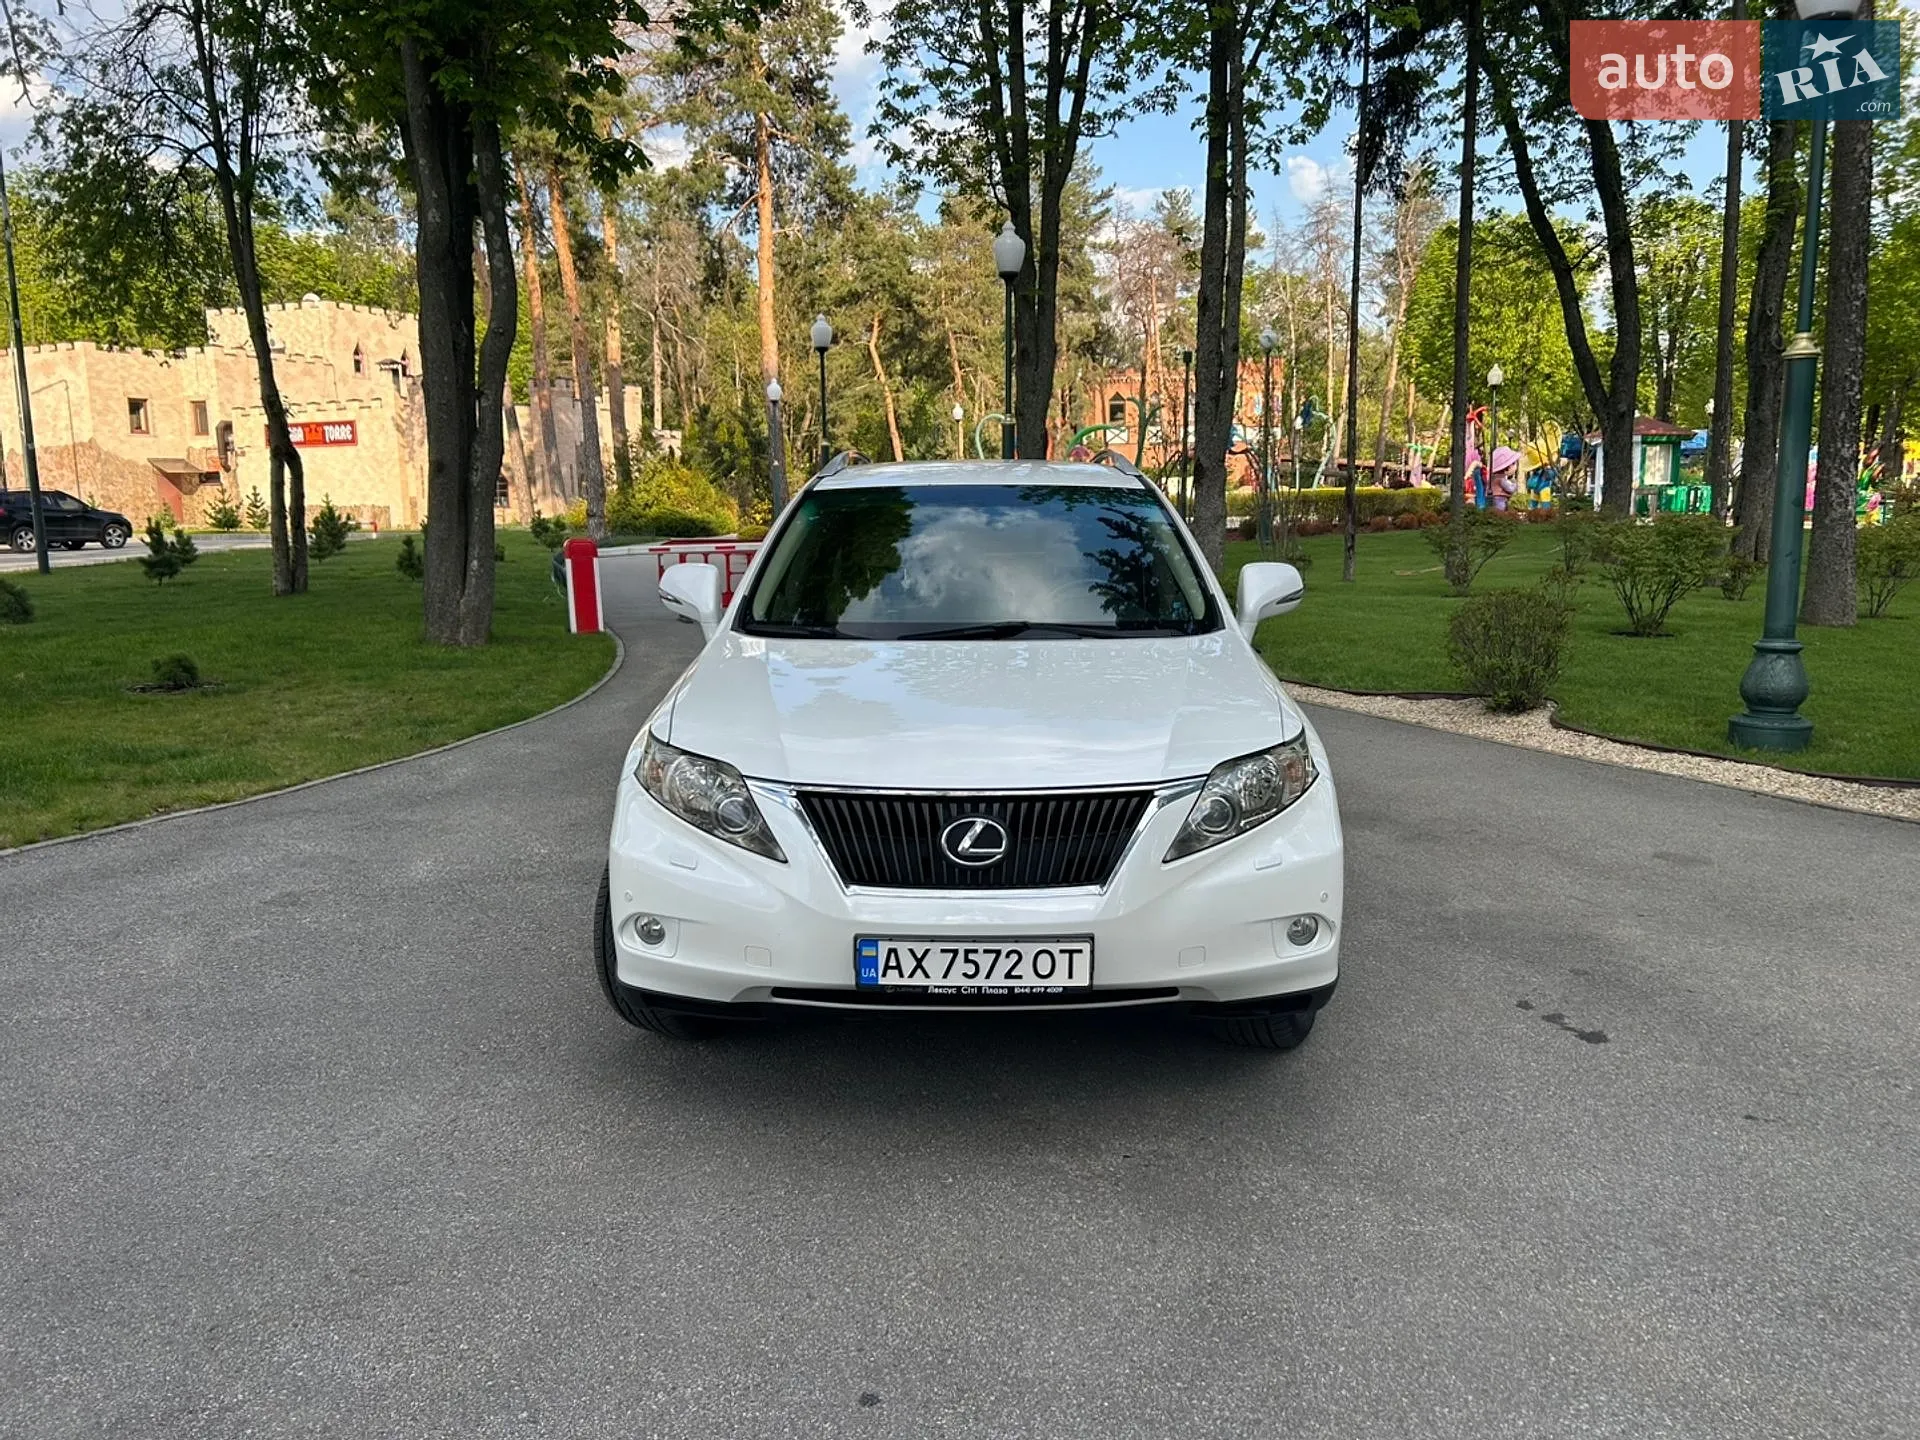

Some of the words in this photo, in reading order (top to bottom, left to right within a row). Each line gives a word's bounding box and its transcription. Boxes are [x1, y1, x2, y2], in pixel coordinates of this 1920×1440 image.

[861, 968, 877, 978] UA
[881, 947, 931, 980] AX
[940, 948, 1024, 980] 7572
[1032, 948, 1084, 980] OT
